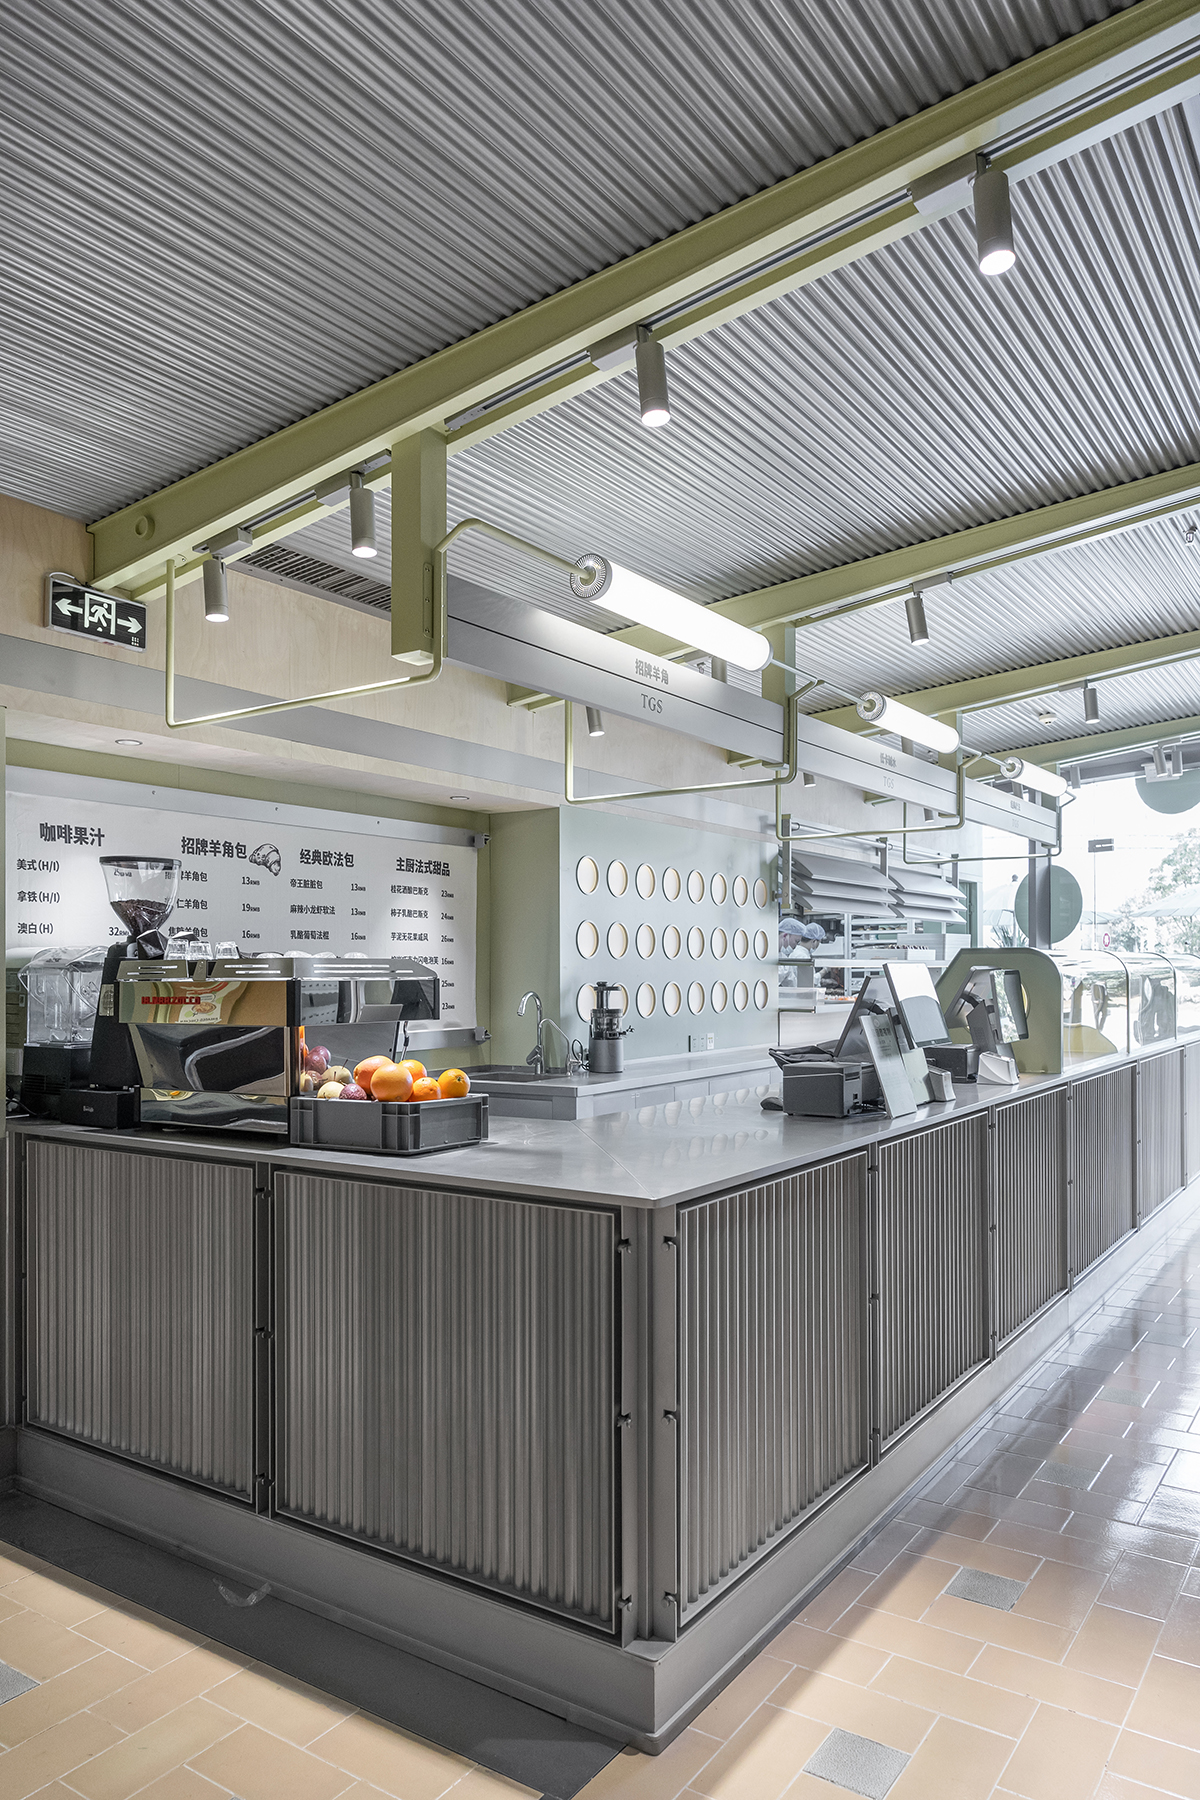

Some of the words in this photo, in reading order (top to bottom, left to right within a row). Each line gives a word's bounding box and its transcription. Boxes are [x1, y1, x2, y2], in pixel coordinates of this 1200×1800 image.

[635, 658, 669, 685] 招牌羊角
[641, 693, 663, 714] TGS
[883, 775, 895, 789] TGS
[39, 822, 105, 847] 咖啡果汁
[181, 836, 247, 859] 招牌羊角包
[300, 848, 355, 868] 经典欧法包
[396, 857, 450, 877] 主厨法式甜品
[241, 876, 260, 886] 13RMB
[17, 890, 60, 904] 拿铁(H/I)
[17, 922, 54, 935] 澳白(H)
